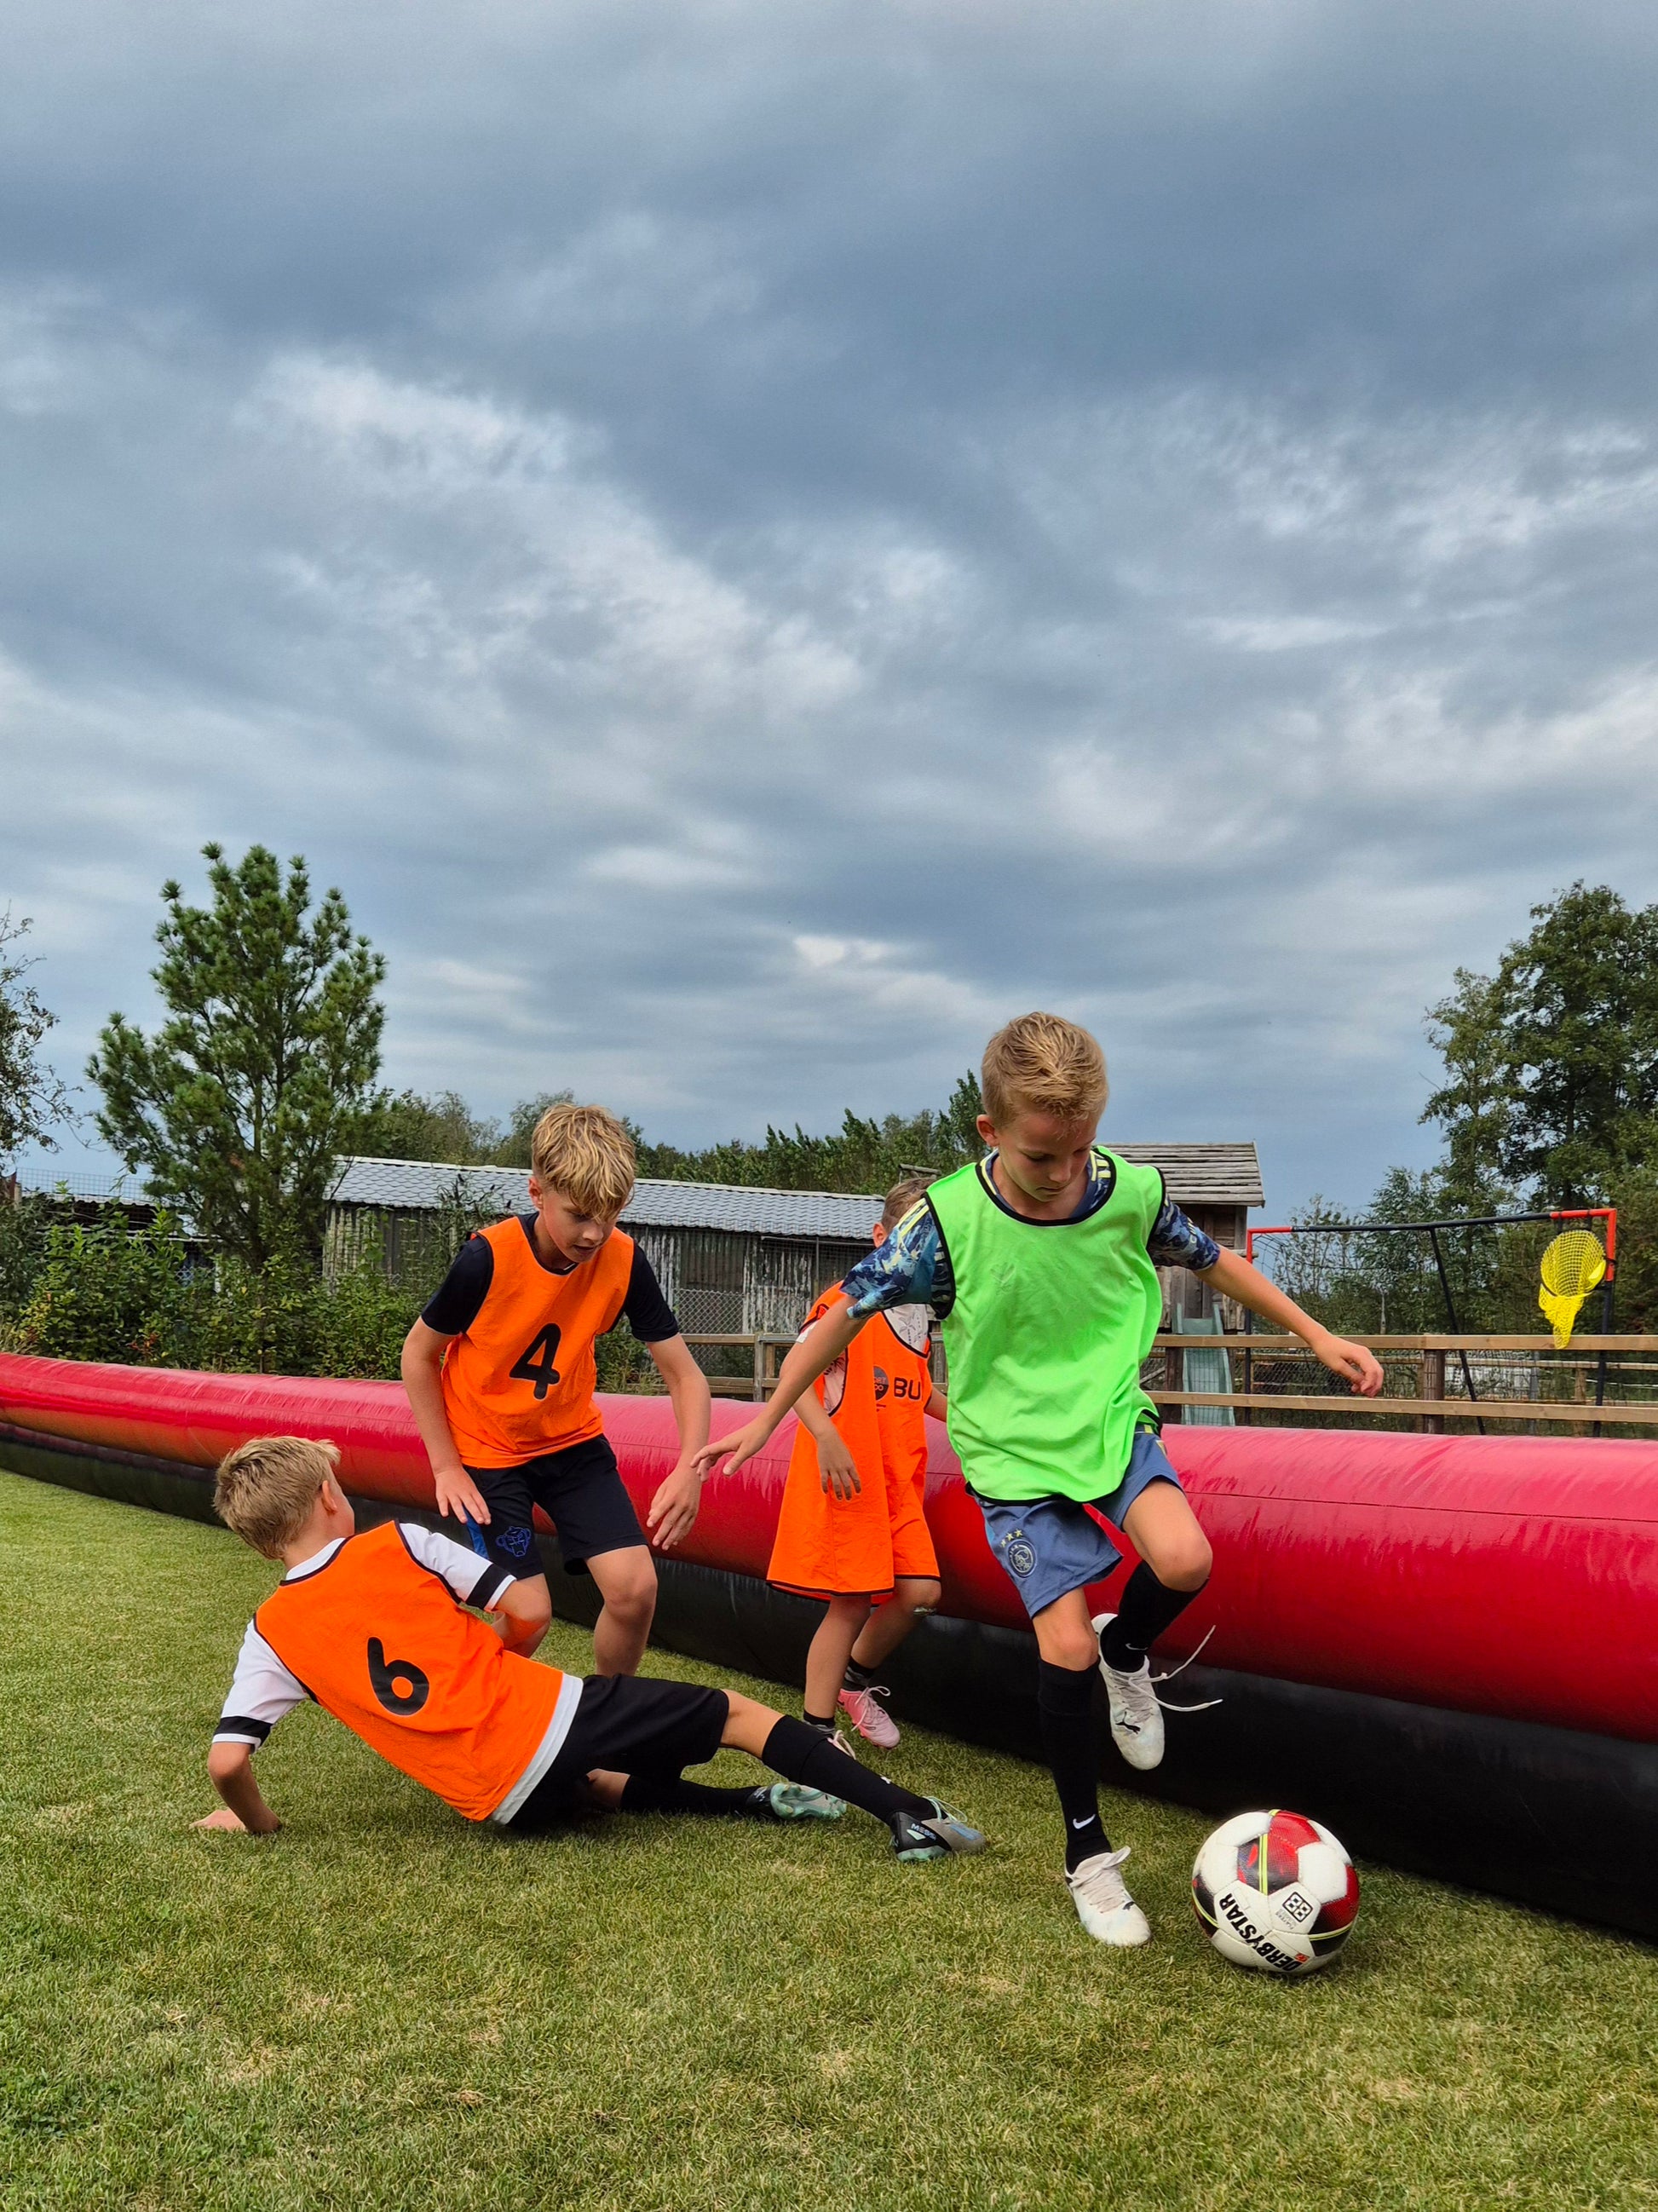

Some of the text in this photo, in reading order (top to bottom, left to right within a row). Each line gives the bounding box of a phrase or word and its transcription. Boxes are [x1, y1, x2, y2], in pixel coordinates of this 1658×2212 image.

[509, 1322, 561, 1400] 4
[367, 1637, 429, 1715] 6
[1219, 1892, 1303, 1971] DERBYSTAR
